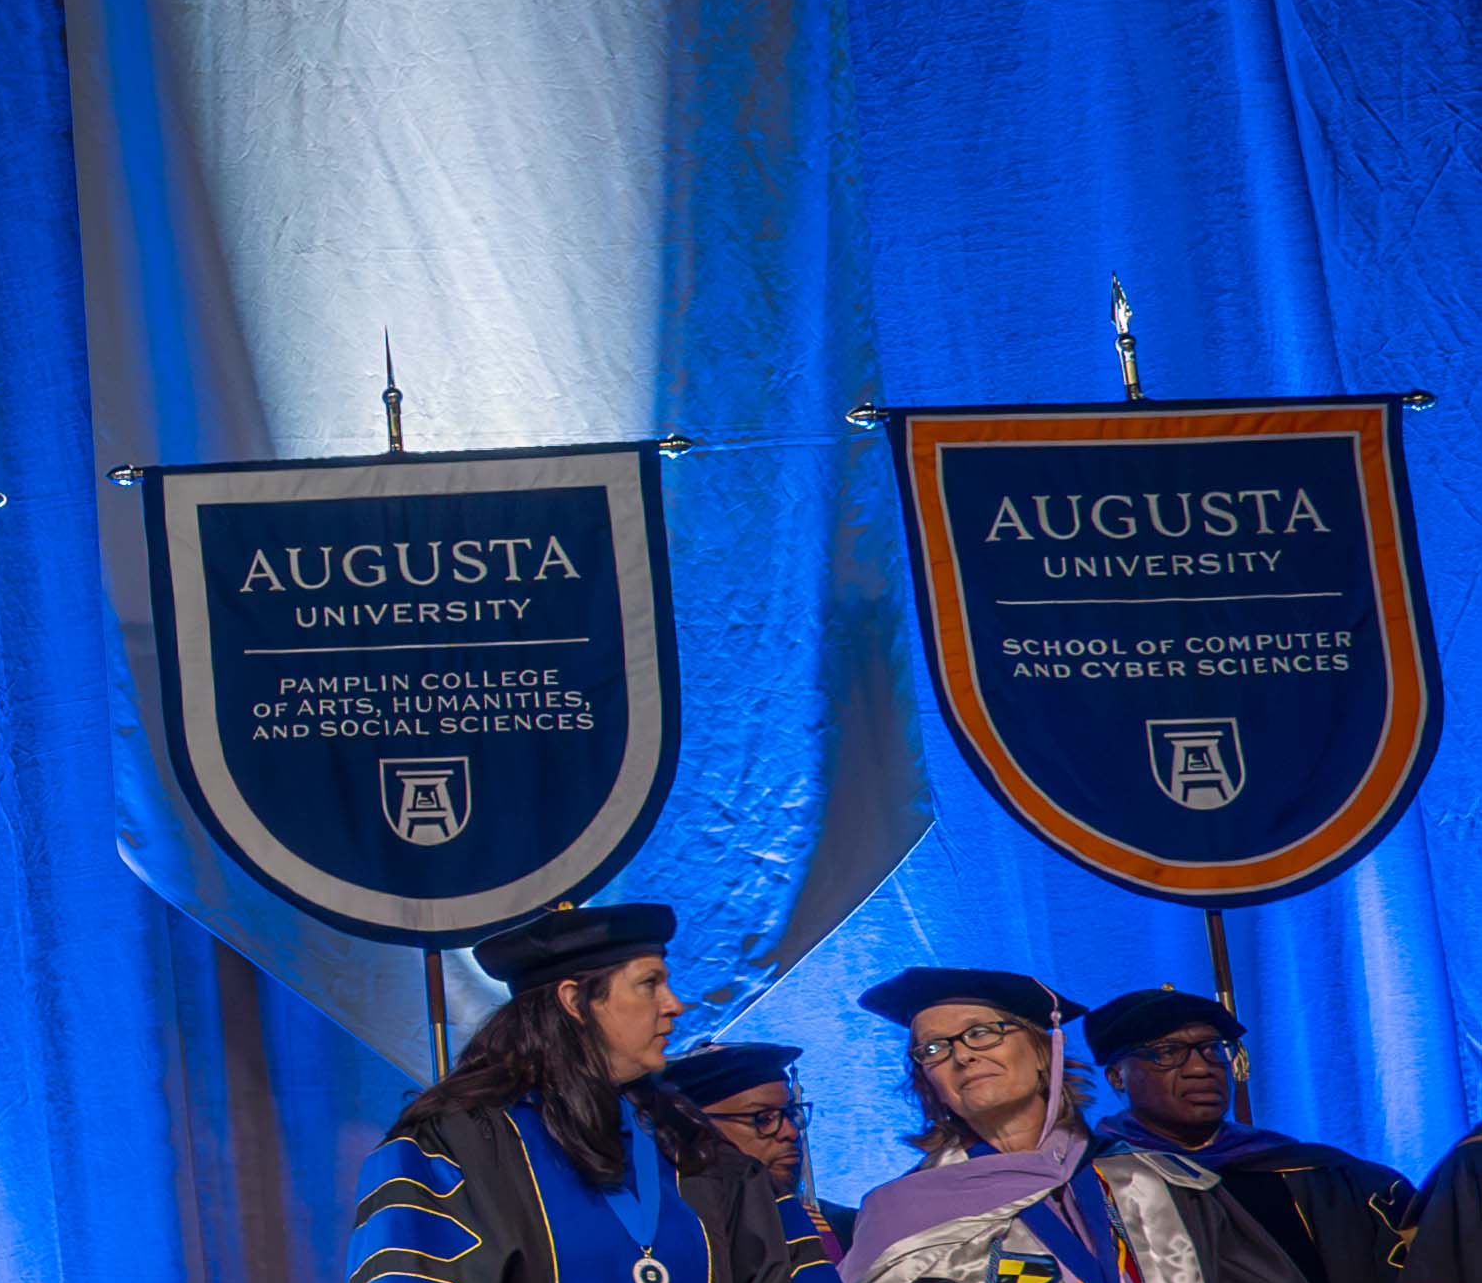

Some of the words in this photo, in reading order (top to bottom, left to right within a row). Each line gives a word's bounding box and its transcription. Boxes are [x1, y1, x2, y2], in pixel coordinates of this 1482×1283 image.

[984, 488, 1331, 542] AUGUSTA
[240, 535, 580, 593] AUGUSTA
[1043, 550, 1282, 579] UNIVERSITY
[295, 599, 532, 628] UNIVERSITY
[1002, 638, 1127, 656] SCHOOL
[1135, 639, 1174, 655] OF
[1185, 631, 1353, 654] COMPUTER
[1013, 662, 1071, 679] AND
[1081, 659, 1186, 679] CYBER
[1197, 654, 1349, 677] SCIENCES
[280, 674, 409, 696] PAMPLIN
[421, 669, 559, 690] COLLEGE
[253, 702, 287, 718] OF
[297, 697, 382, 718] ARTS,
[393, 691, 591, 714] HUMANITIES,
[252, 724, 310, 741] AND
[320, 718, 430, 737] SOCIAL
[439, 713, 595, 734] SCIENCES
